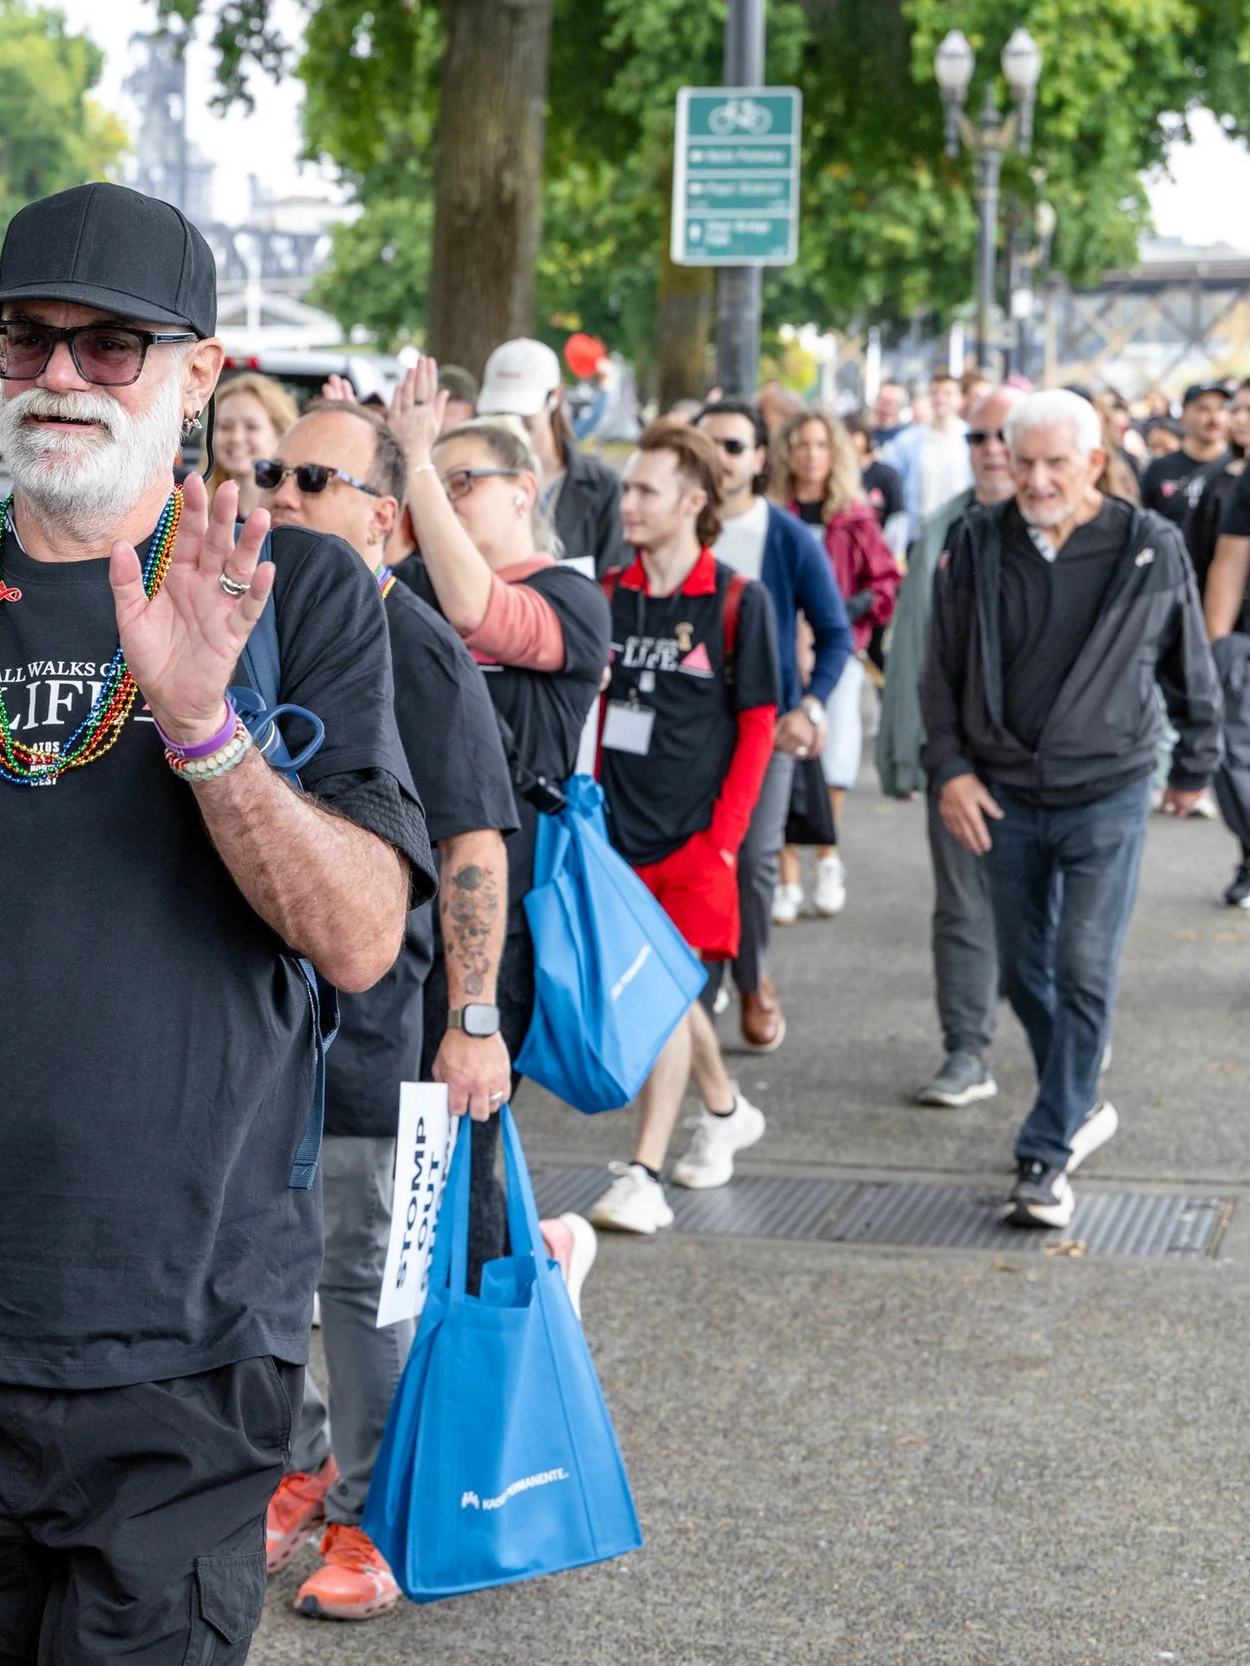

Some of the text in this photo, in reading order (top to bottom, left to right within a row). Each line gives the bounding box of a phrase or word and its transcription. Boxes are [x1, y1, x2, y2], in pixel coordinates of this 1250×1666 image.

[27, 660, 96, 678] WALKS
[396, 1116, 427, 1289] STOMP
[417, 1152, 440, 1252] OUT
